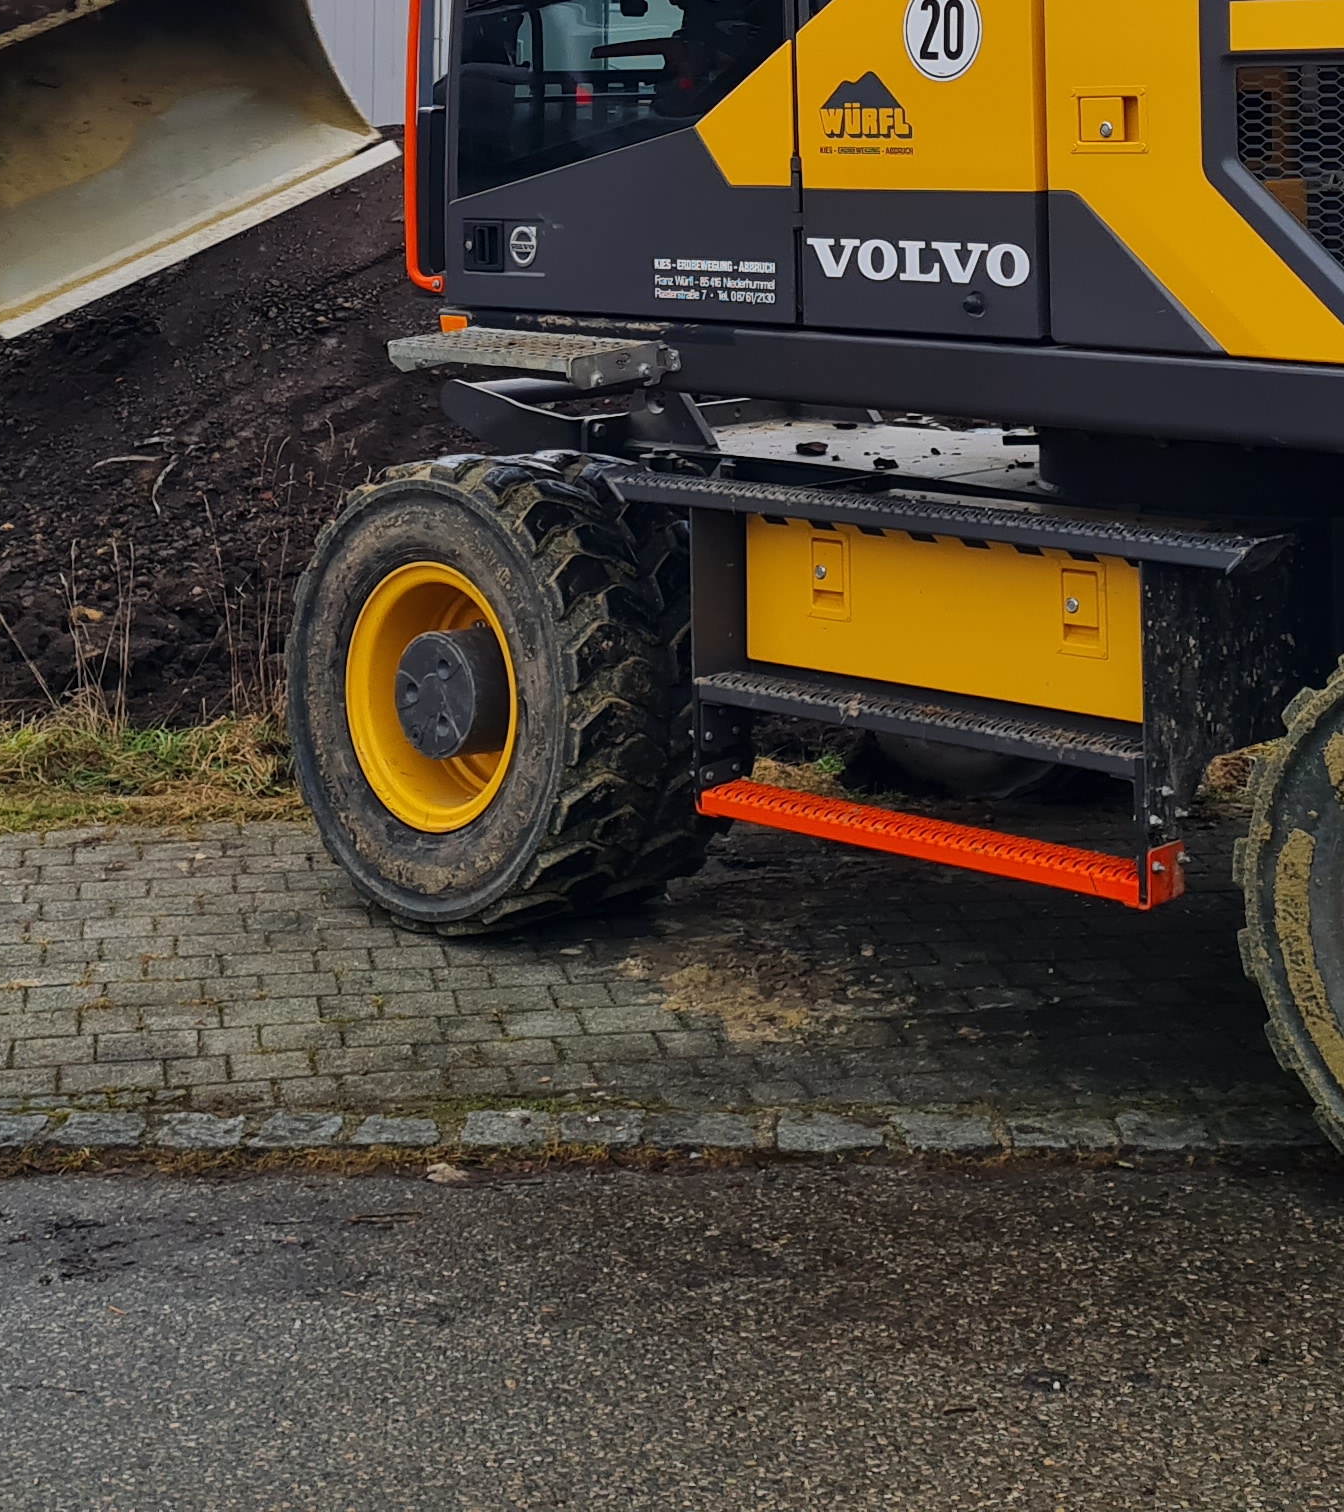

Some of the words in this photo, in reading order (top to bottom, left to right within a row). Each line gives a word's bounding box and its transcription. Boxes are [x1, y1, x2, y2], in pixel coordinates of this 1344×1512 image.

[819, 101, 913, 138] WÜRFL
[654, 258, 671, 269] KIES
[807, 237, 1030, 287] VOLVO
